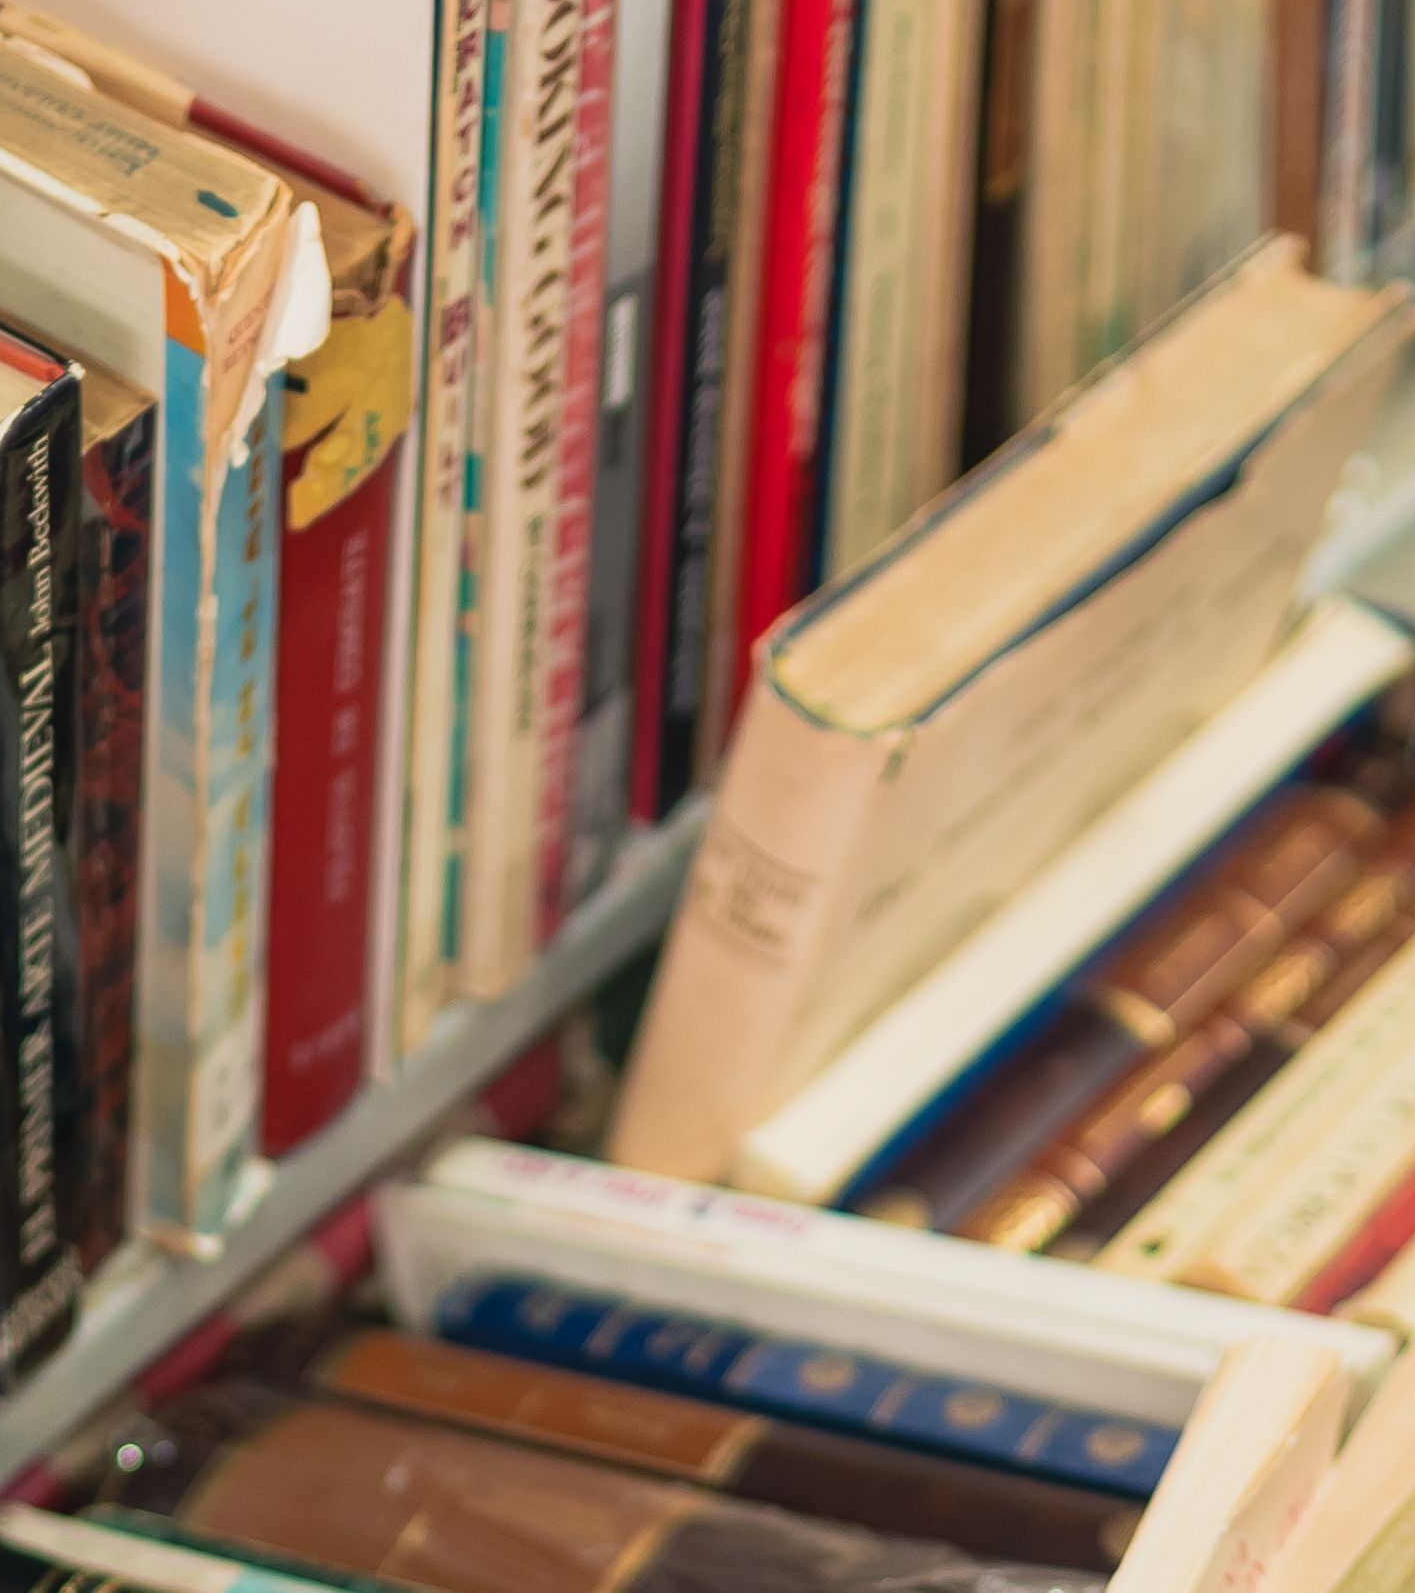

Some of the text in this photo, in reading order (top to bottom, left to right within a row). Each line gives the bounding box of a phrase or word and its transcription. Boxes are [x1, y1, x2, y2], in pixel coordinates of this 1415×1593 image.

[25, 432, 57, 565] Beckwith
[29, 568, 54, 636] John
[13, 642, 57, 900] MEDIEVAL
